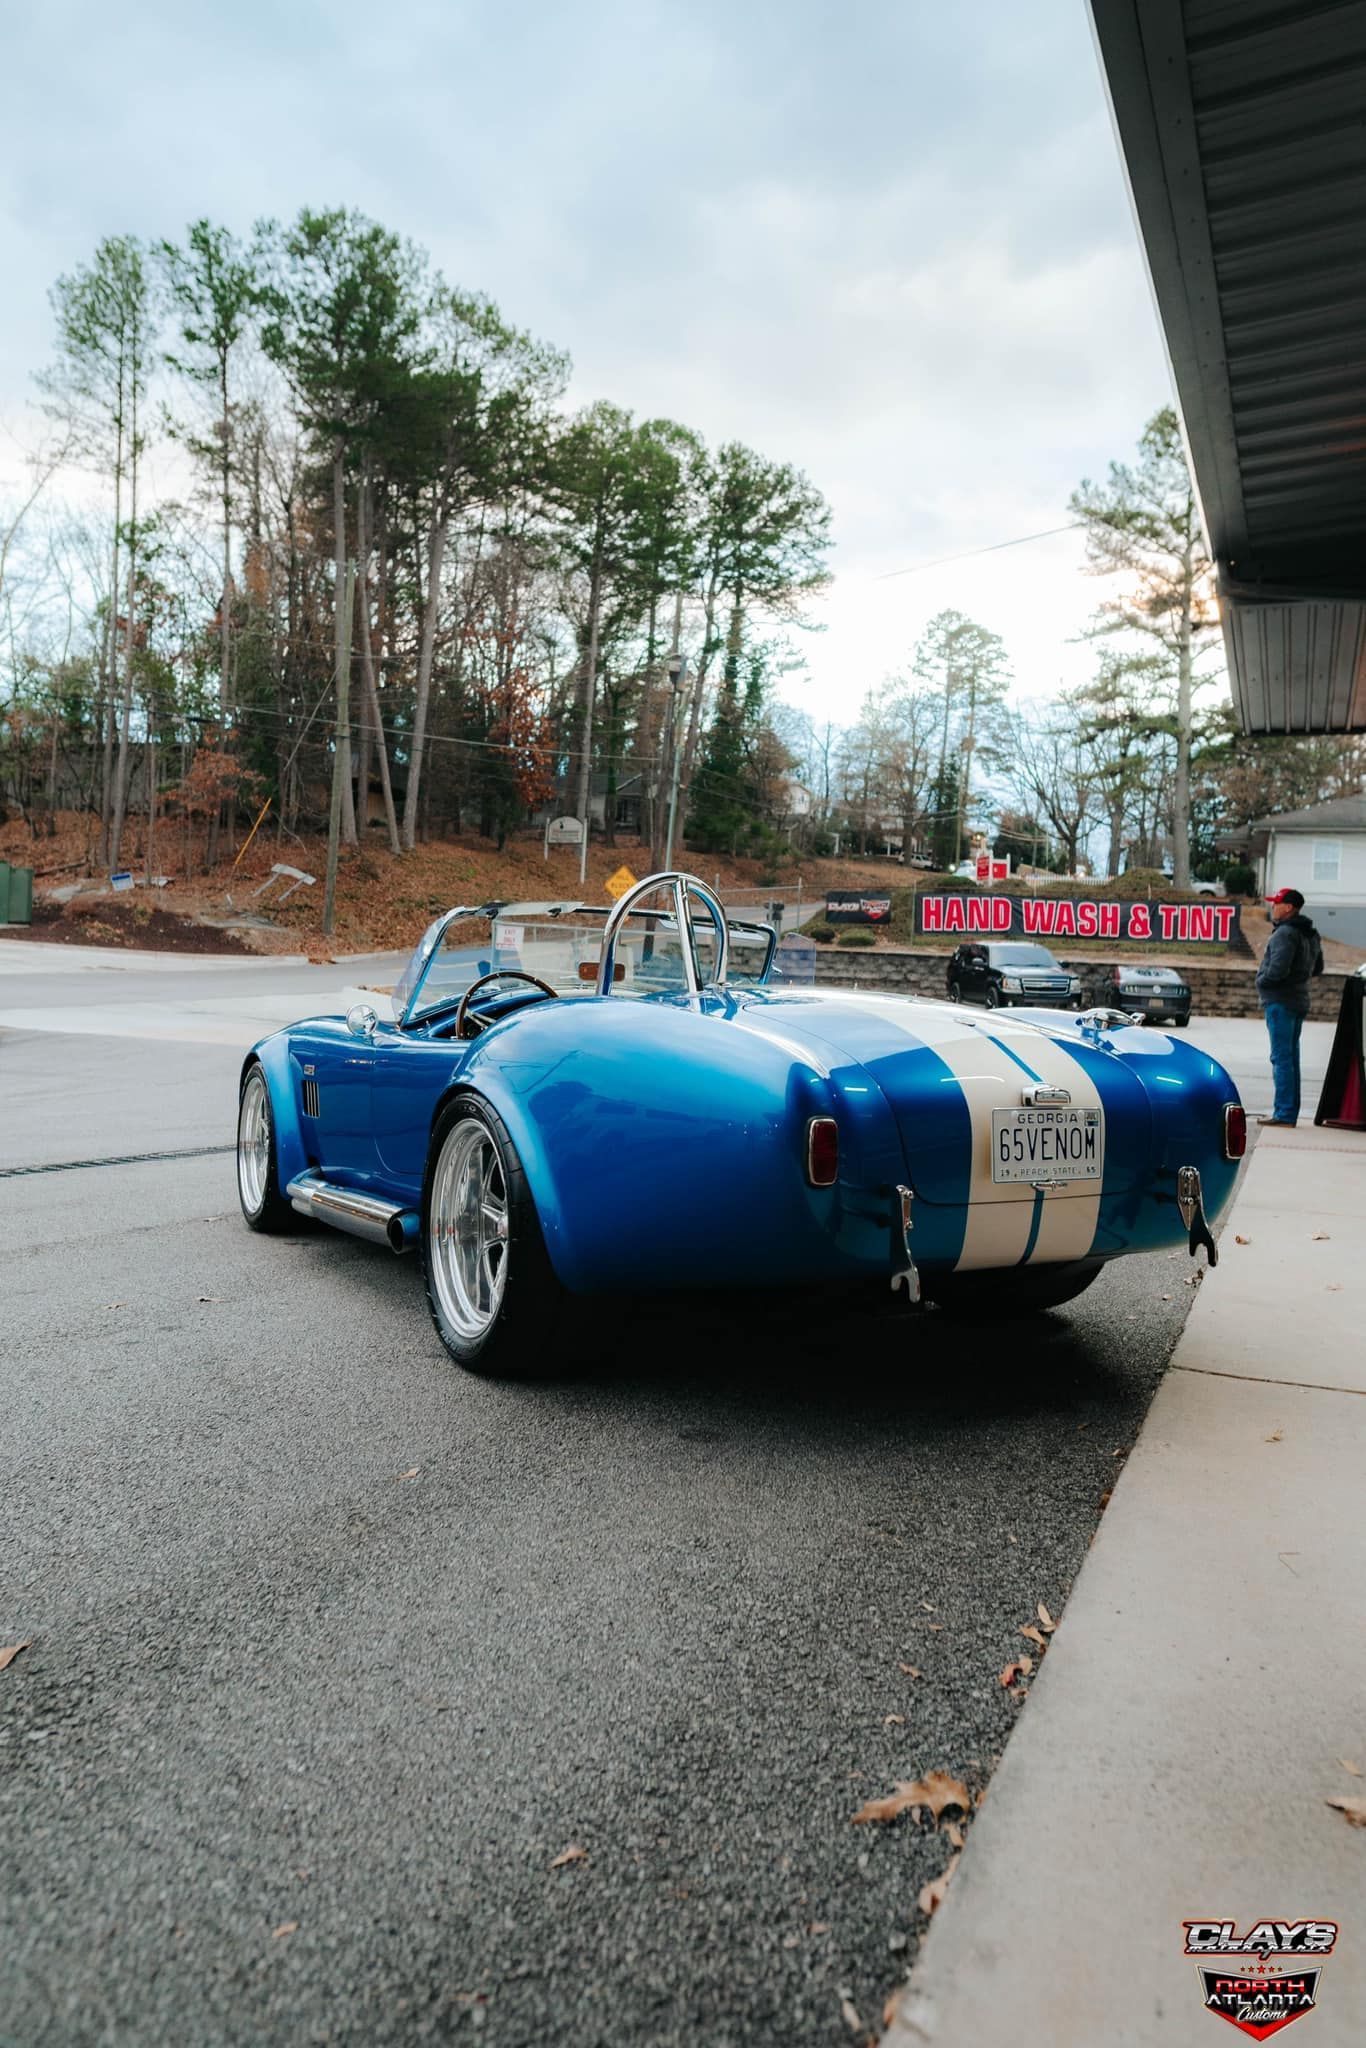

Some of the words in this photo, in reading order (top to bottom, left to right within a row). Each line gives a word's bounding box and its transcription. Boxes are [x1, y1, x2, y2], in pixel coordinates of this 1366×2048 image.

[921, 896, 1012, 932] HAND
[1022, 900, 1120, 938] WASH
[1128, 903, 1152, 939] &
[1158, 904, 1235, 941] TINT
[1017, 1113, 1078, 1124] GEORGIA
[1000, 1127, 1095, 1161] 65VENOM
[1020, 1168, 1048, 1176] PEACH
[1052, 1166, 1078, 1175] STATE
